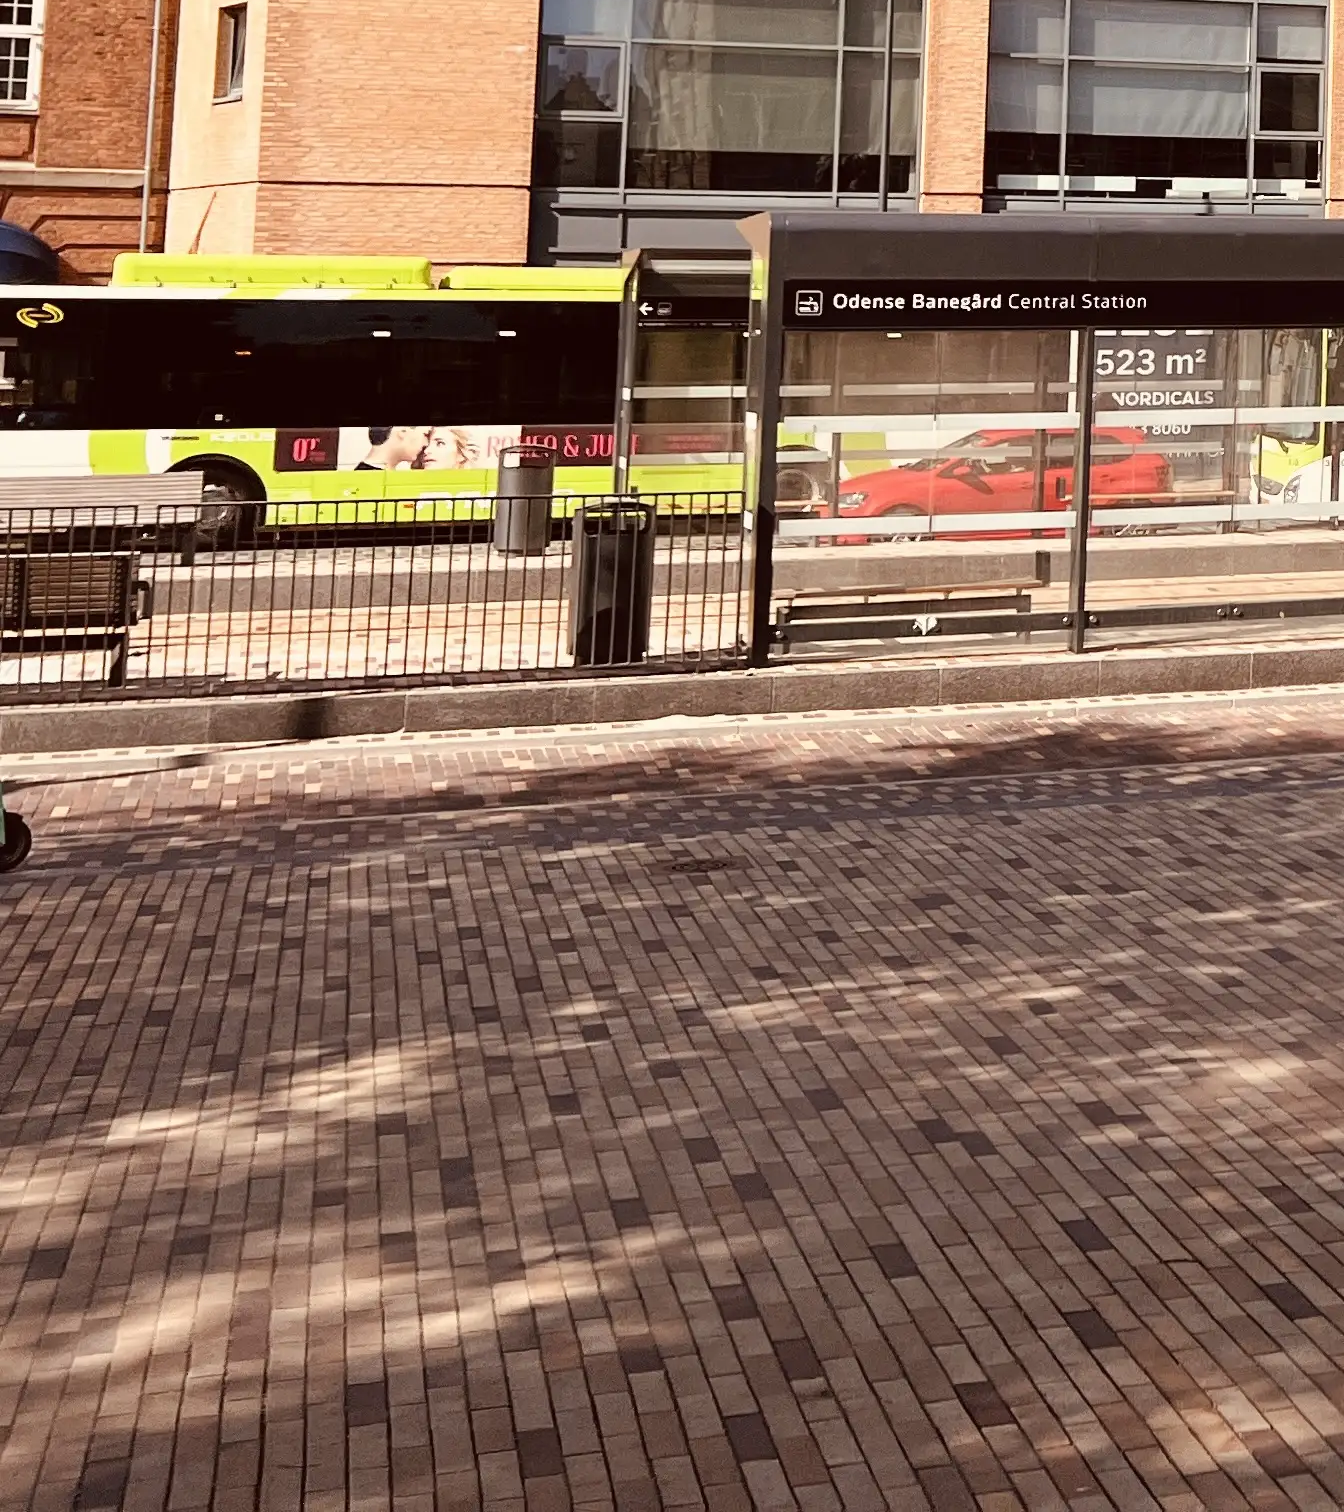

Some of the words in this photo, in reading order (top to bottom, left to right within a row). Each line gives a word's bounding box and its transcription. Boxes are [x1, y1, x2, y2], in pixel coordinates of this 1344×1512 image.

[833, 294, 905, 310] Odense
[913, 293, 1002, 312] Banegård
[1009, 293, 1075, 310] Central
[1082, 293, 1147, 310] Station
[1095, 349, 1155, 375] 523
[1112, 391, 1214, 406] NORDICALS
[563, 434, 580, 458] &
